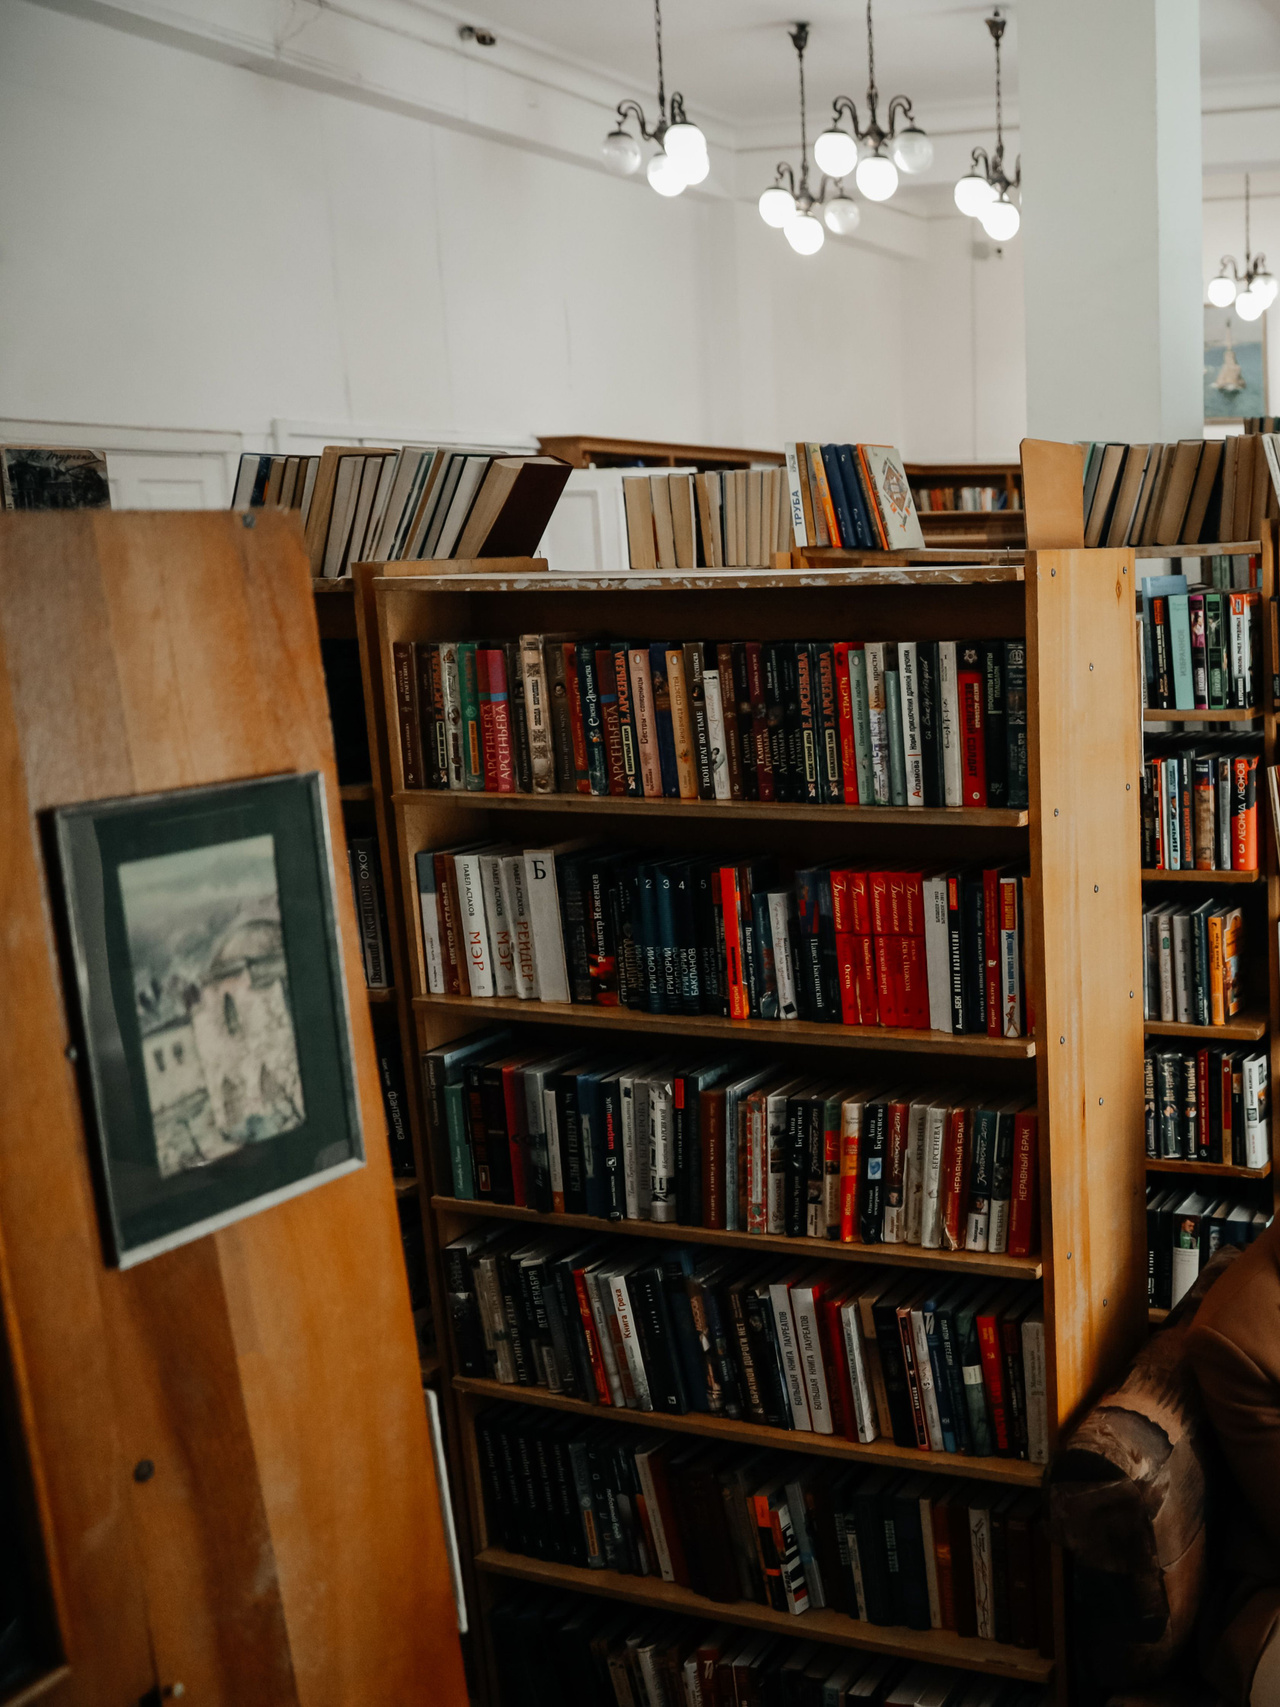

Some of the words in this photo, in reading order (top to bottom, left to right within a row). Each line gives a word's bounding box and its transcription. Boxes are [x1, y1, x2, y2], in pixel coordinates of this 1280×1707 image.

[792, 490, 802, 526] ТРУБА
[615, 651, 628, 712] АРСЕНЬЕВА
[696, 711, 704, 731] ТЬМЕ
[496, 704, 510, 780] АРСЕНЬЕВА
[1237, 763, 1245, 800] ЛЕОНОВ
[532, 861, 546, 879] Б
[645, 879, 652, 888] 2
[663, 880, 670, 888] 3
[447, 930, 457, 965] ВИКТОР
[469, 931, 484, 971] МЭР
[497, 931, 511, 971] МЭР
[647, 947, 657, 993] ГРИГОРИЙ
[664, 948, 674, 994] ГРИГОРИЙ
[688, 948, 699, 995] БАКЛАНОВ
[605, 1097, 615, 1150] шарманщик
[1021, 1128, 1030, 1151] БРАК
[1016, 1153, 1028, 1201] НЕРАВНЫЙ
[616, 1289, 626, 1311] Греха
[622, 1315, 631, 1338] Книга
[779, 1311, 792, 1347] ЛАУРЕАТОВ
[800, 1315, 813, 1351] ЛАУРЕАТОВ
[786, 1351, 796, 1371] КНИГА
[807, 1355, 816, 1375] КНИГА
[791, 1374, 802, 1406] БОЛЬШАЯ
[811, 1379, 822, 1410] БОЛЬШАЯ
